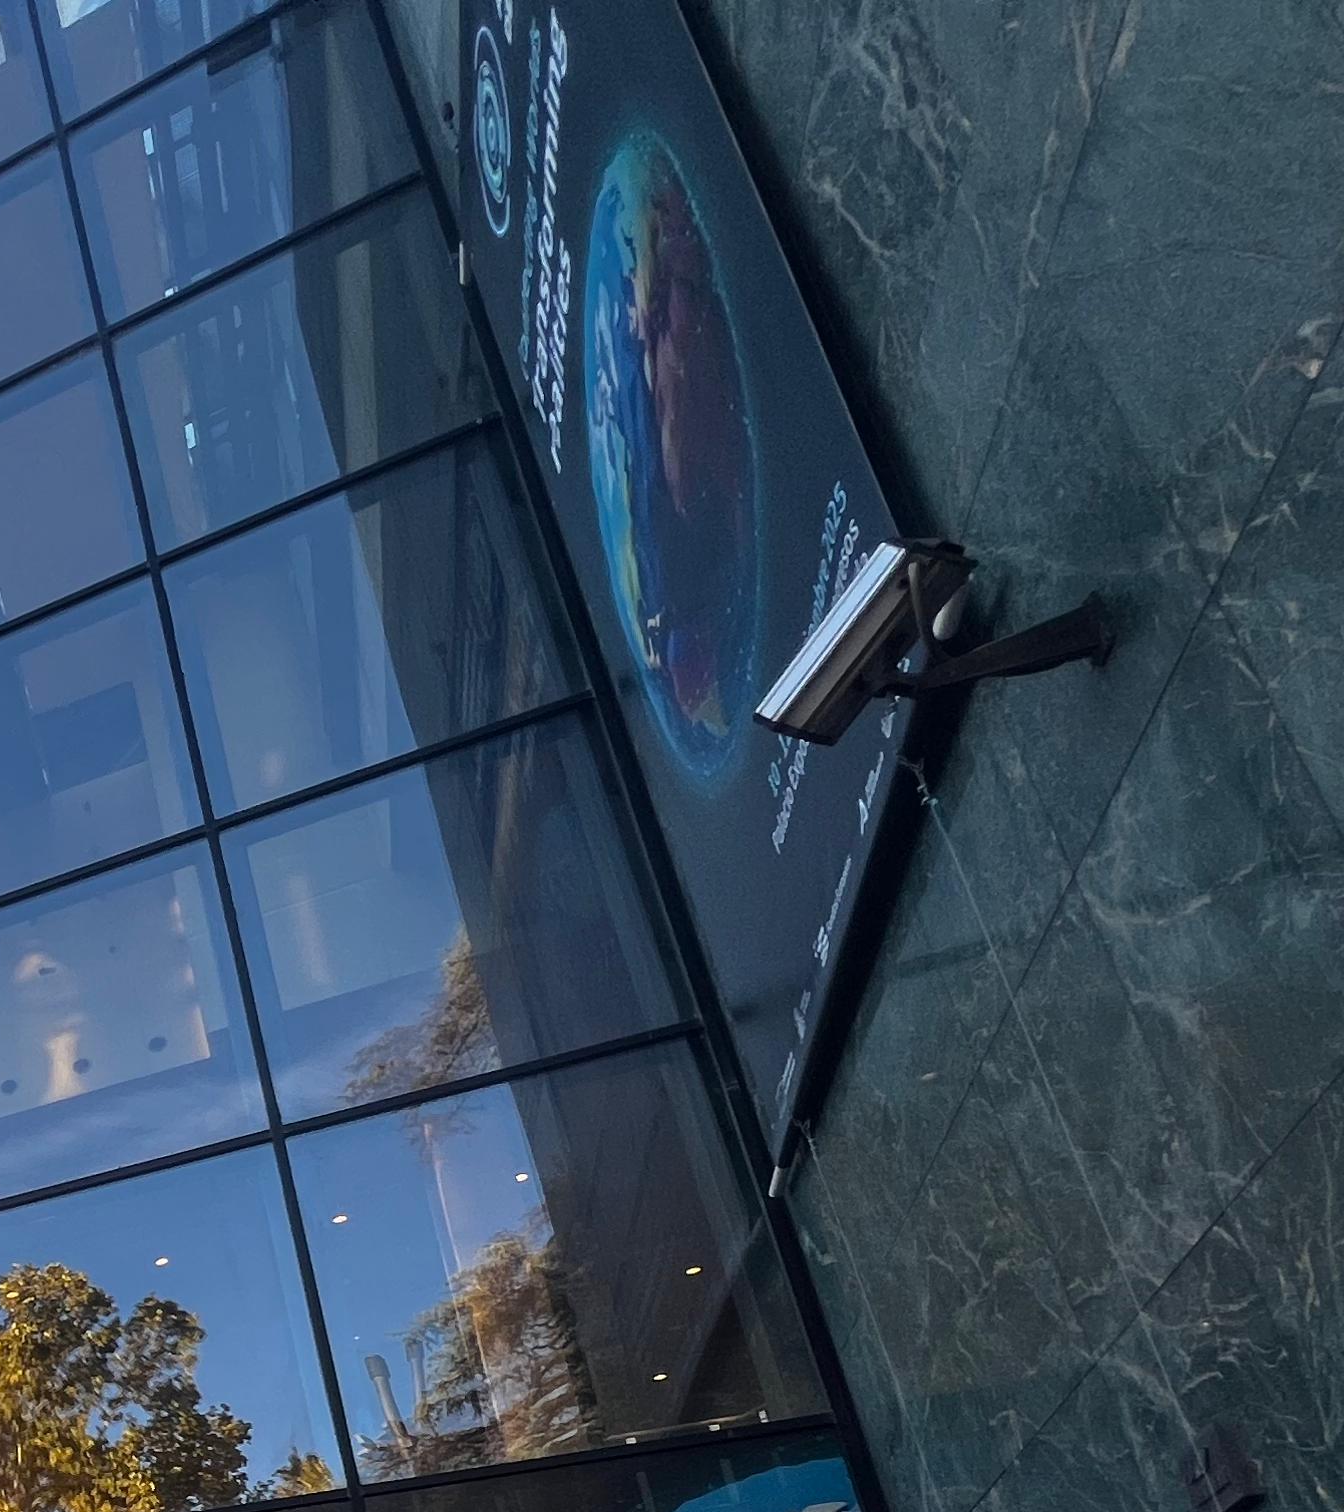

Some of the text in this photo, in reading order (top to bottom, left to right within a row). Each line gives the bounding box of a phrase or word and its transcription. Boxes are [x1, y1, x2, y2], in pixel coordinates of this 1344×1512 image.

[533, 6, 568, 423] Transforming
[550, 238, 571, 474] realities
[822, 480, 847, 563] 2025
